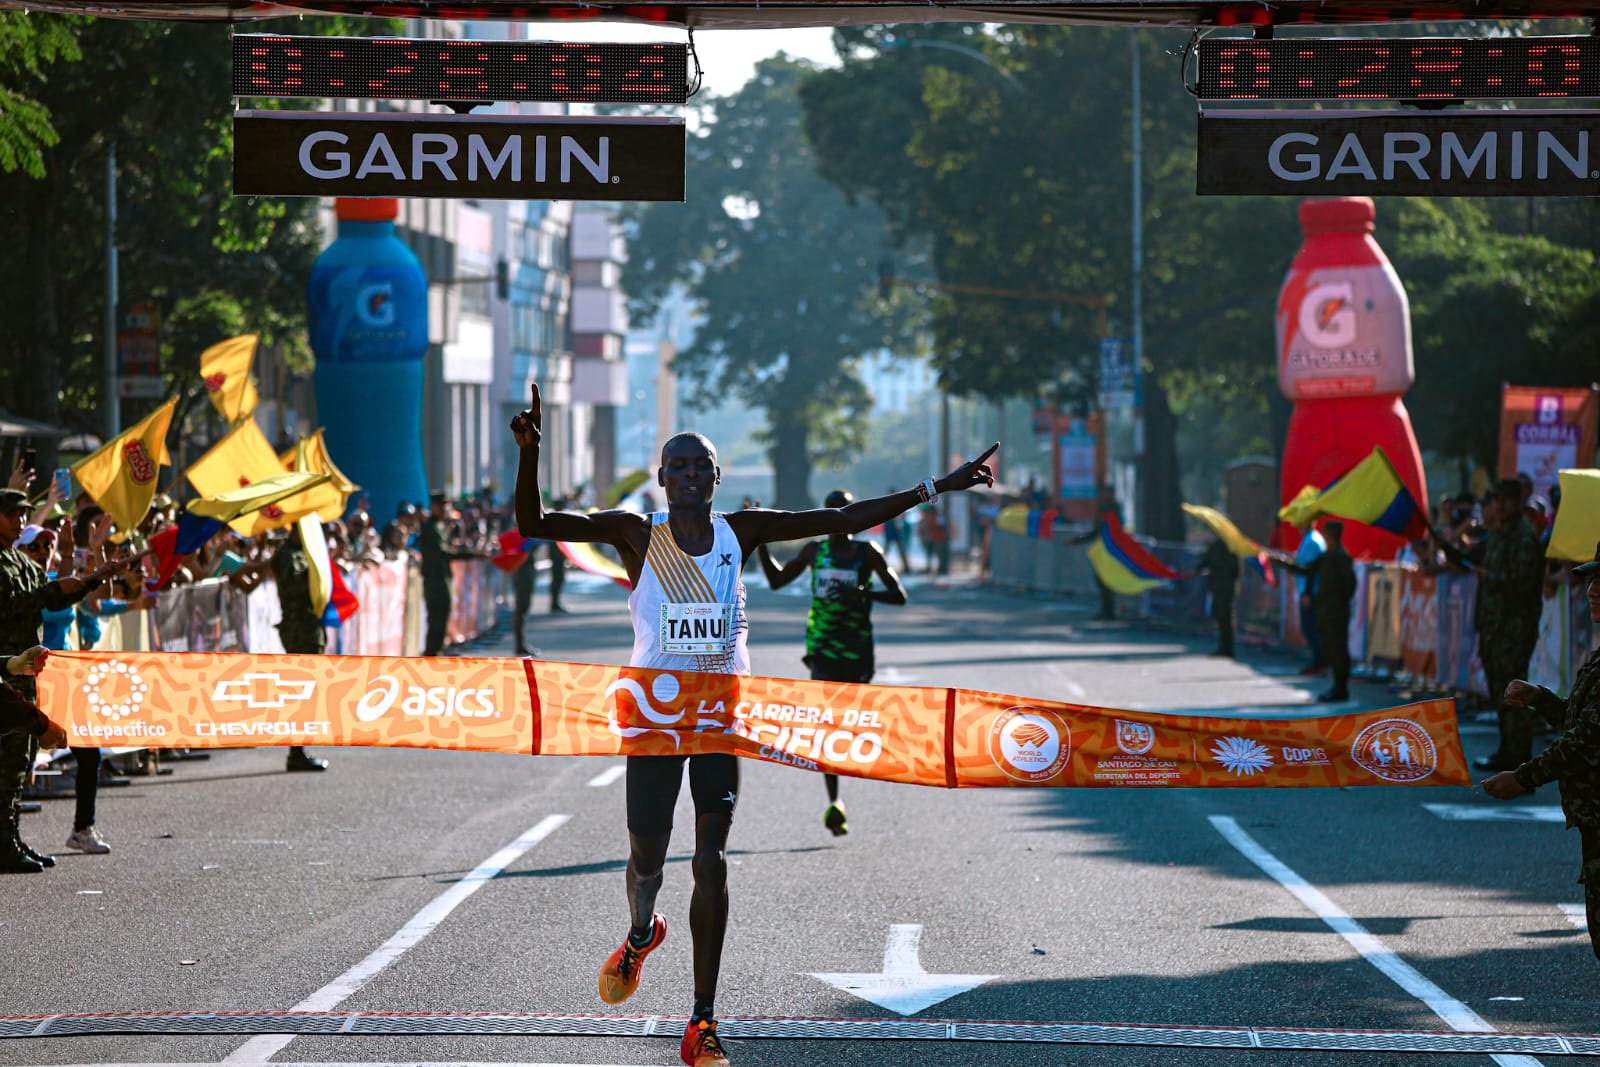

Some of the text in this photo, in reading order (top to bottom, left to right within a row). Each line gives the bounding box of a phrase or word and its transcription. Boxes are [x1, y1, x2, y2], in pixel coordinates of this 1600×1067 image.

[252, 37, 671, 101] 0:28:04
[298, 130, 610, 184] GARMIN
[1267, 131, 1590, 182] GARMIN
[1299, 281, 1356, 348] G
[1539, 396, 1559, 423] B
[401, 685, 496, 719] asics
[696, 699, 883, 728] LA CARRERA DEL
[71, 721, 167, 740] telepacífico
[194, 721, 333, 737] CHEVROLET
[1012, 756, 1049, 764] ATHLETICS
[1017, 750, 1043, 758] WORLD
[1097, 761, 1142, 769] SANTIAGO
[1281, 746, 1328, 762] COP16
